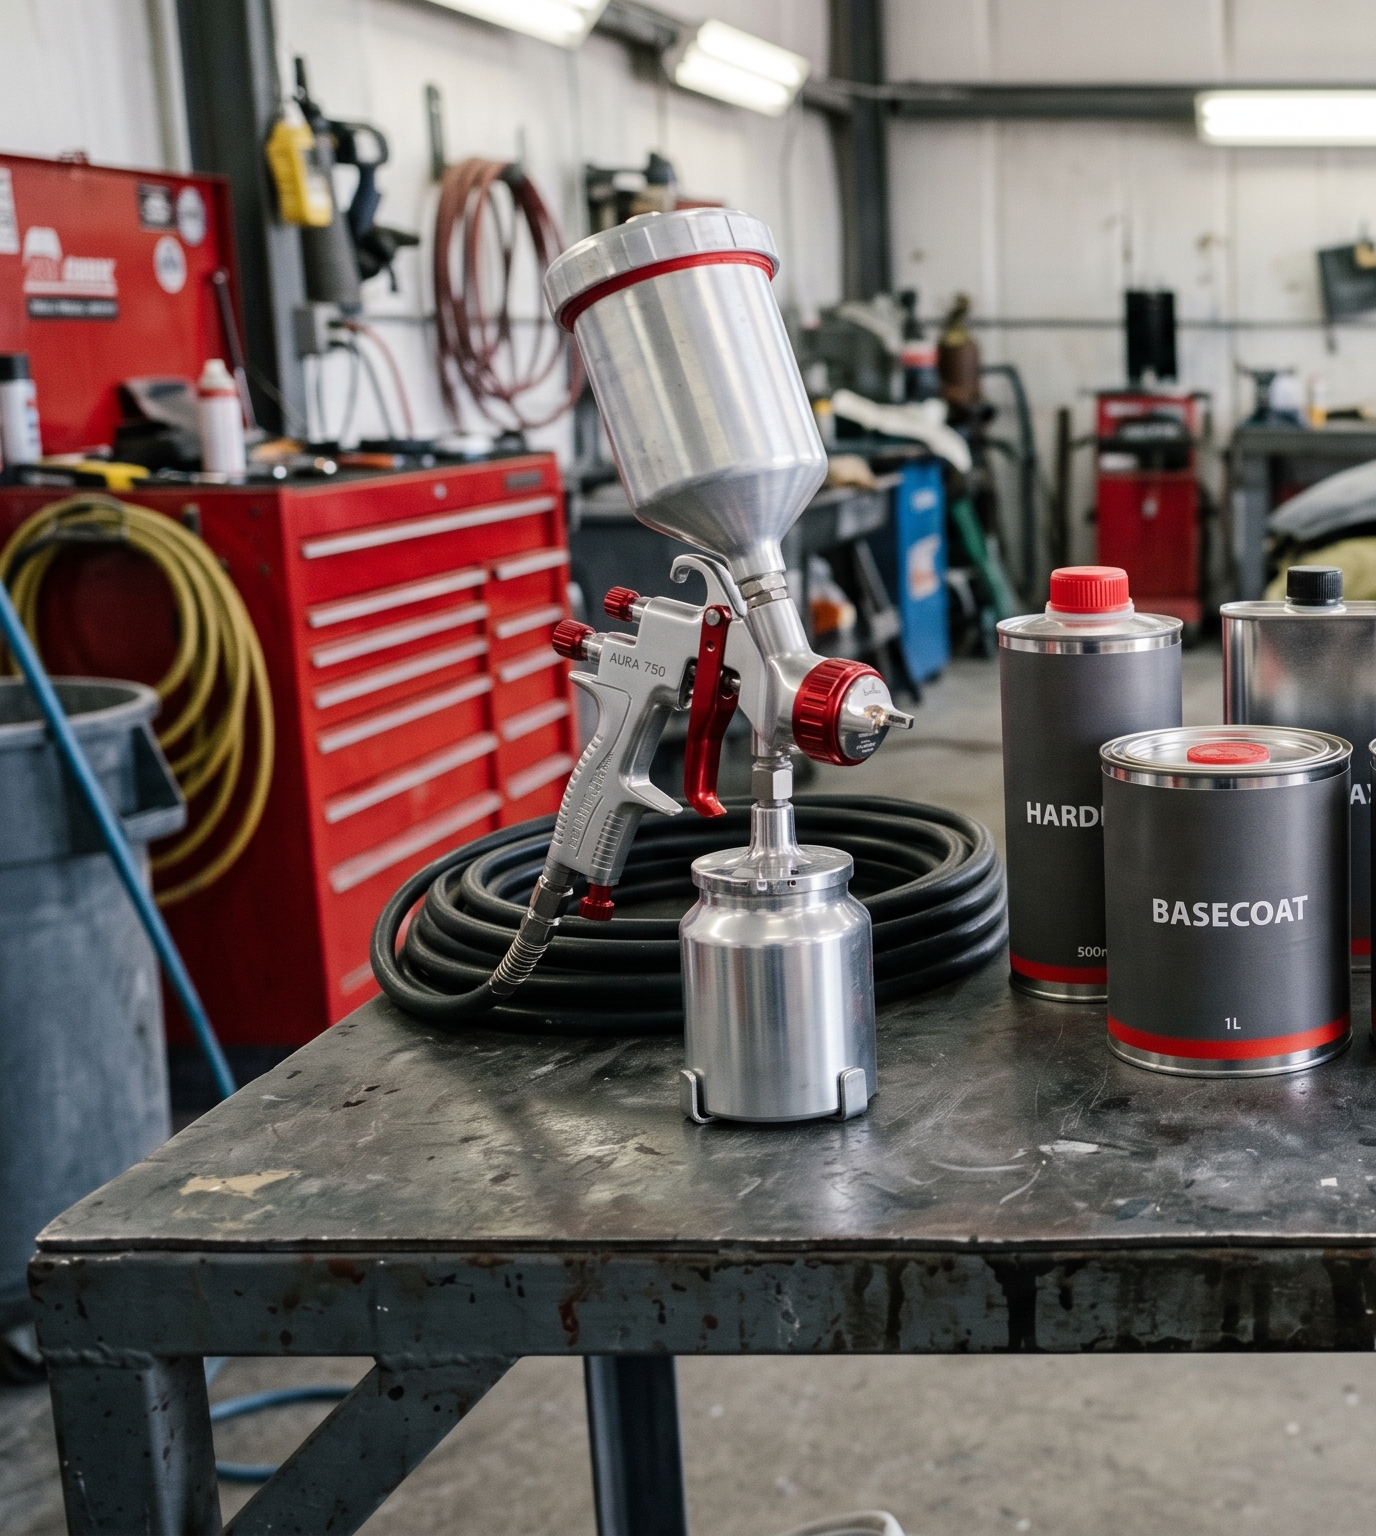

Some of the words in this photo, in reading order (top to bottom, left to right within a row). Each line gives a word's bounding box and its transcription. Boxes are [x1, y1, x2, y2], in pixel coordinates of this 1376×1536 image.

[609, 652, 639, 670] AURA
[644, 660, 666, 677] 750
[1026, 801, 1104, 828] HARD
[1153, 895, 1308, 927] BASECOAT
[1224, 1017, 1242, 1030] 1L
